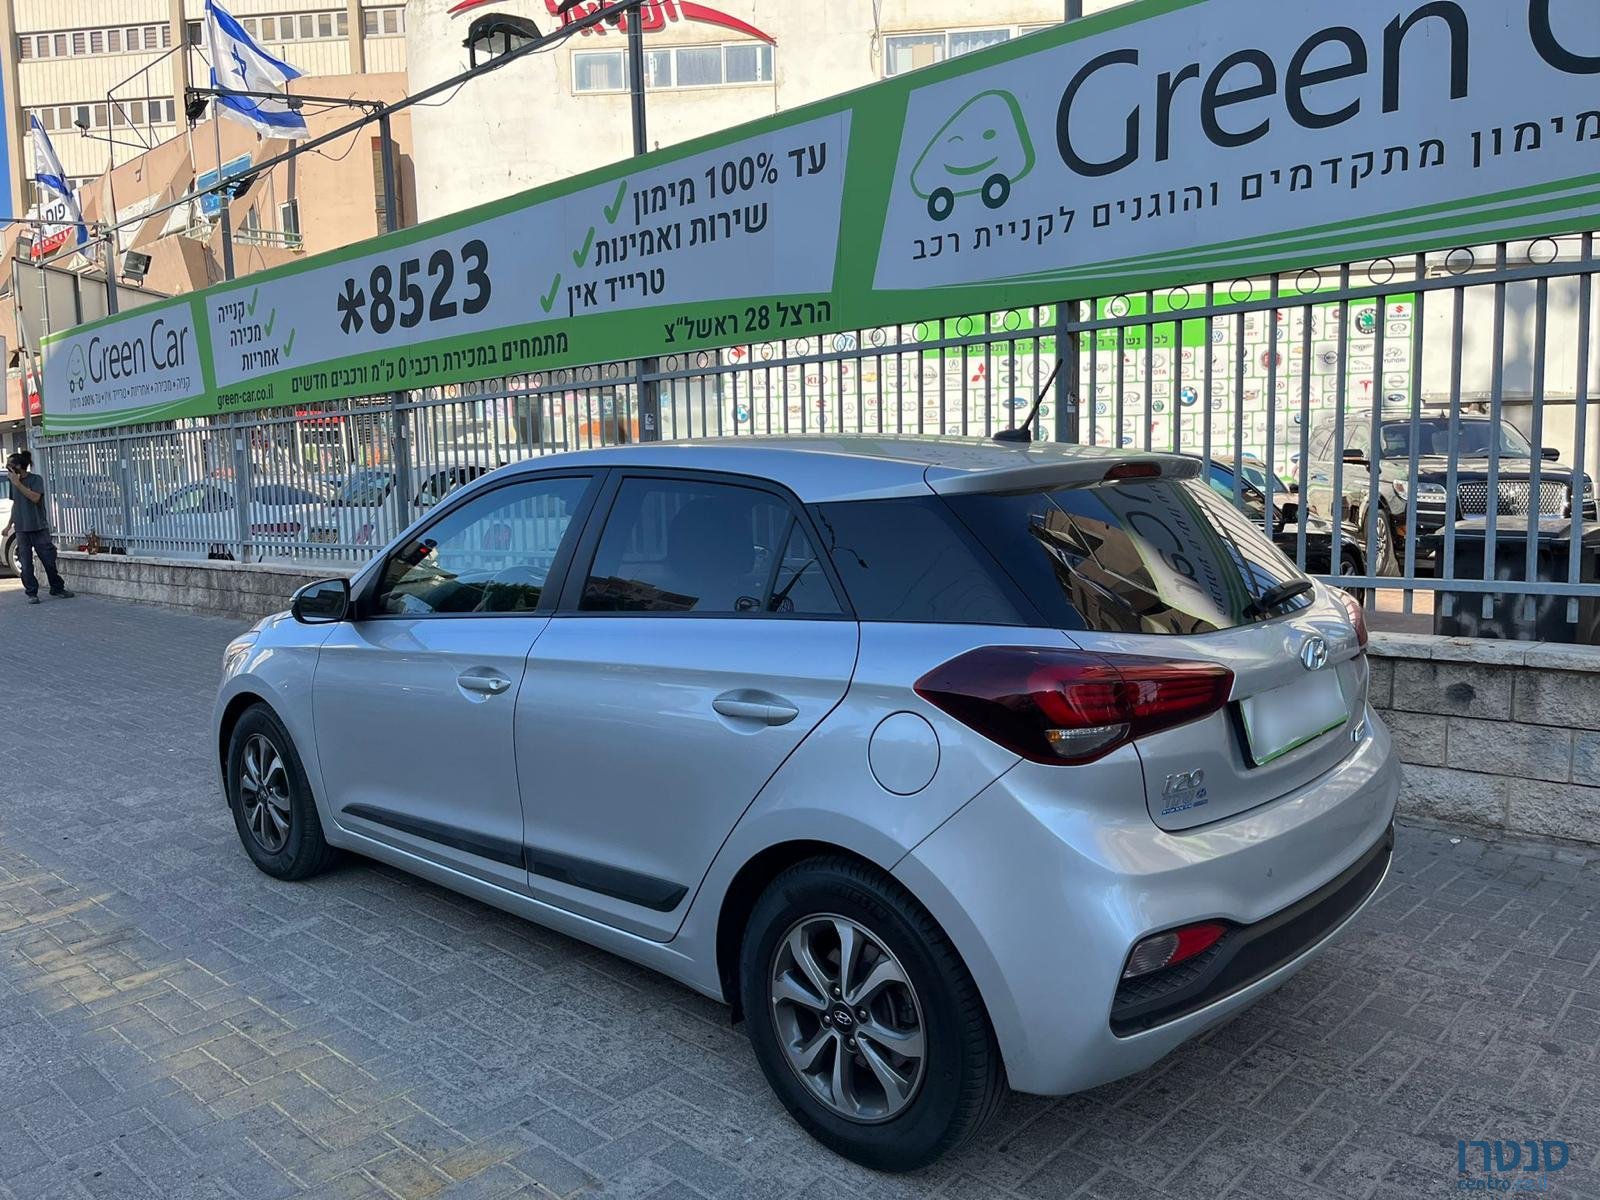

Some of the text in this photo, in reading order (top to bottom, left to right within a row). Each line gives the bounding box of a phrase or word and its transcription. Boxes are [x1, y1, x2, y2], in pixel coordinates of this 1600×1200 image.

[1056, 0, 1469, 178] Green
[1241, 139, 1445, 200] מתקדמים
[633, 142, 826, 225] עד 100% מימון
[1092, 181, 1219, 228] והוגנים
[595, 202, 768, 267] שירות ואמינות
[973, 206, 1076, 249] לקניית
[912, 232, 960, 260] רכב
[567, 268, 665, 317] טרייד אין
[218, 301, 245, 324] קנייה
[744, 305, 770, 332] 28
[776, 301, 831, 328] הרצל
[230, 324, 262, 347] מכירה
[502, 331, 568, 361] מתמחים
[88, 318, 188, 384] Green Car
[242, 347, 280, 371] אחריות
[443, 344, 497, 371] במכירת
[331, 365, 368, 387] ורכבים
[410, 355, 439, 376] רכבי
[217, 383, 274, 409] green-car.co.il
[292, 372, 328, 393] חדשים
